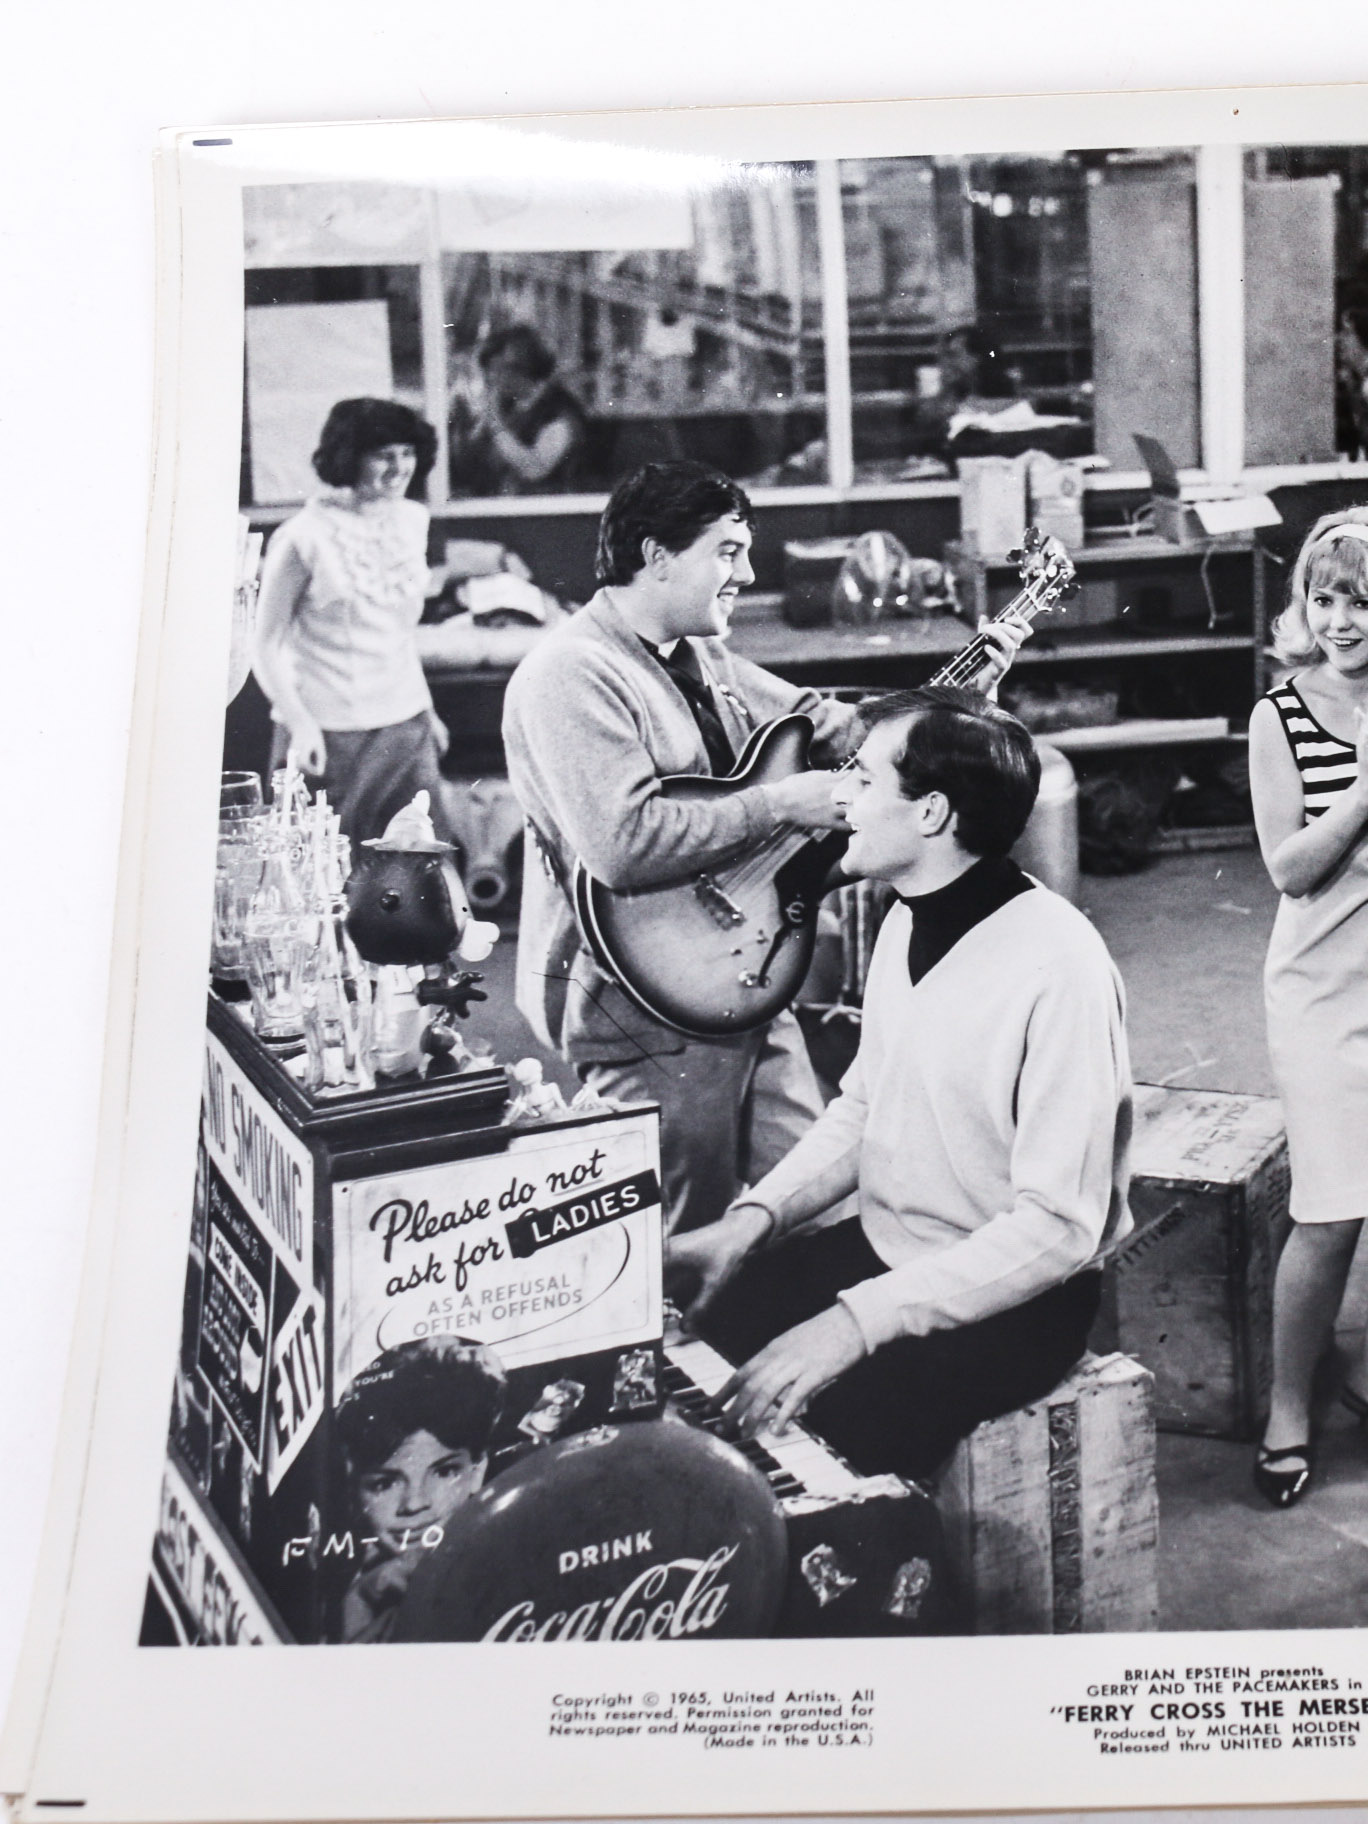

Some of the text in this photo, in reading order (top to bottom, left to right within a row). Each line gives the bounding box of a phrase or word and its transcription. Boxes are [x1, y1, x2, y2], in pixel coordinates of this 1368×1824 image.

[231, 1083, 302, 1262] SMOKING
[369, 1148, 607, 1263] Please do not
[385, 1184, 641, 1297] ask for LADIES
[428, 1273, 571, 1316] AS A REFUSAL
[412, 1289, 584, 1339] OFTEN OFFENDS
[275, 1303, 324, 1458] EXIT
[558, 1529, 655, 1575] DRINK
[1123, 1665, 1324, 1681] BRIAN EPSTEIN presents
[1086, 1678, 1362, 1697] GERRY AND THE PACEMAKERS in
[551, 1692, 633, 1708] Copyright
[670, 1690, 712, 1706] 1965,
[722, 1689, 774, 1703] United
[784, 1689, 841, 1703] Artists.
[851, 1688, 874, 1701] All
[550, 1703, 874, 1723] rights reserved. Permission granted for
[1149, 1701, 1226, 1720] CROSS
[1240, 1700, 1284, 1718] THE
[548, 1718, 874, 1737] Newspaper and Magazine reproduction.
[1093, 1720, 1360, 1741] Produced by MICHAEL HOLDEN
[703, 1732, 874, 1749] (Made in the U.S.A.)
[1100, 1734, 1356, 1754] Released thru UNITED ARTISTS
